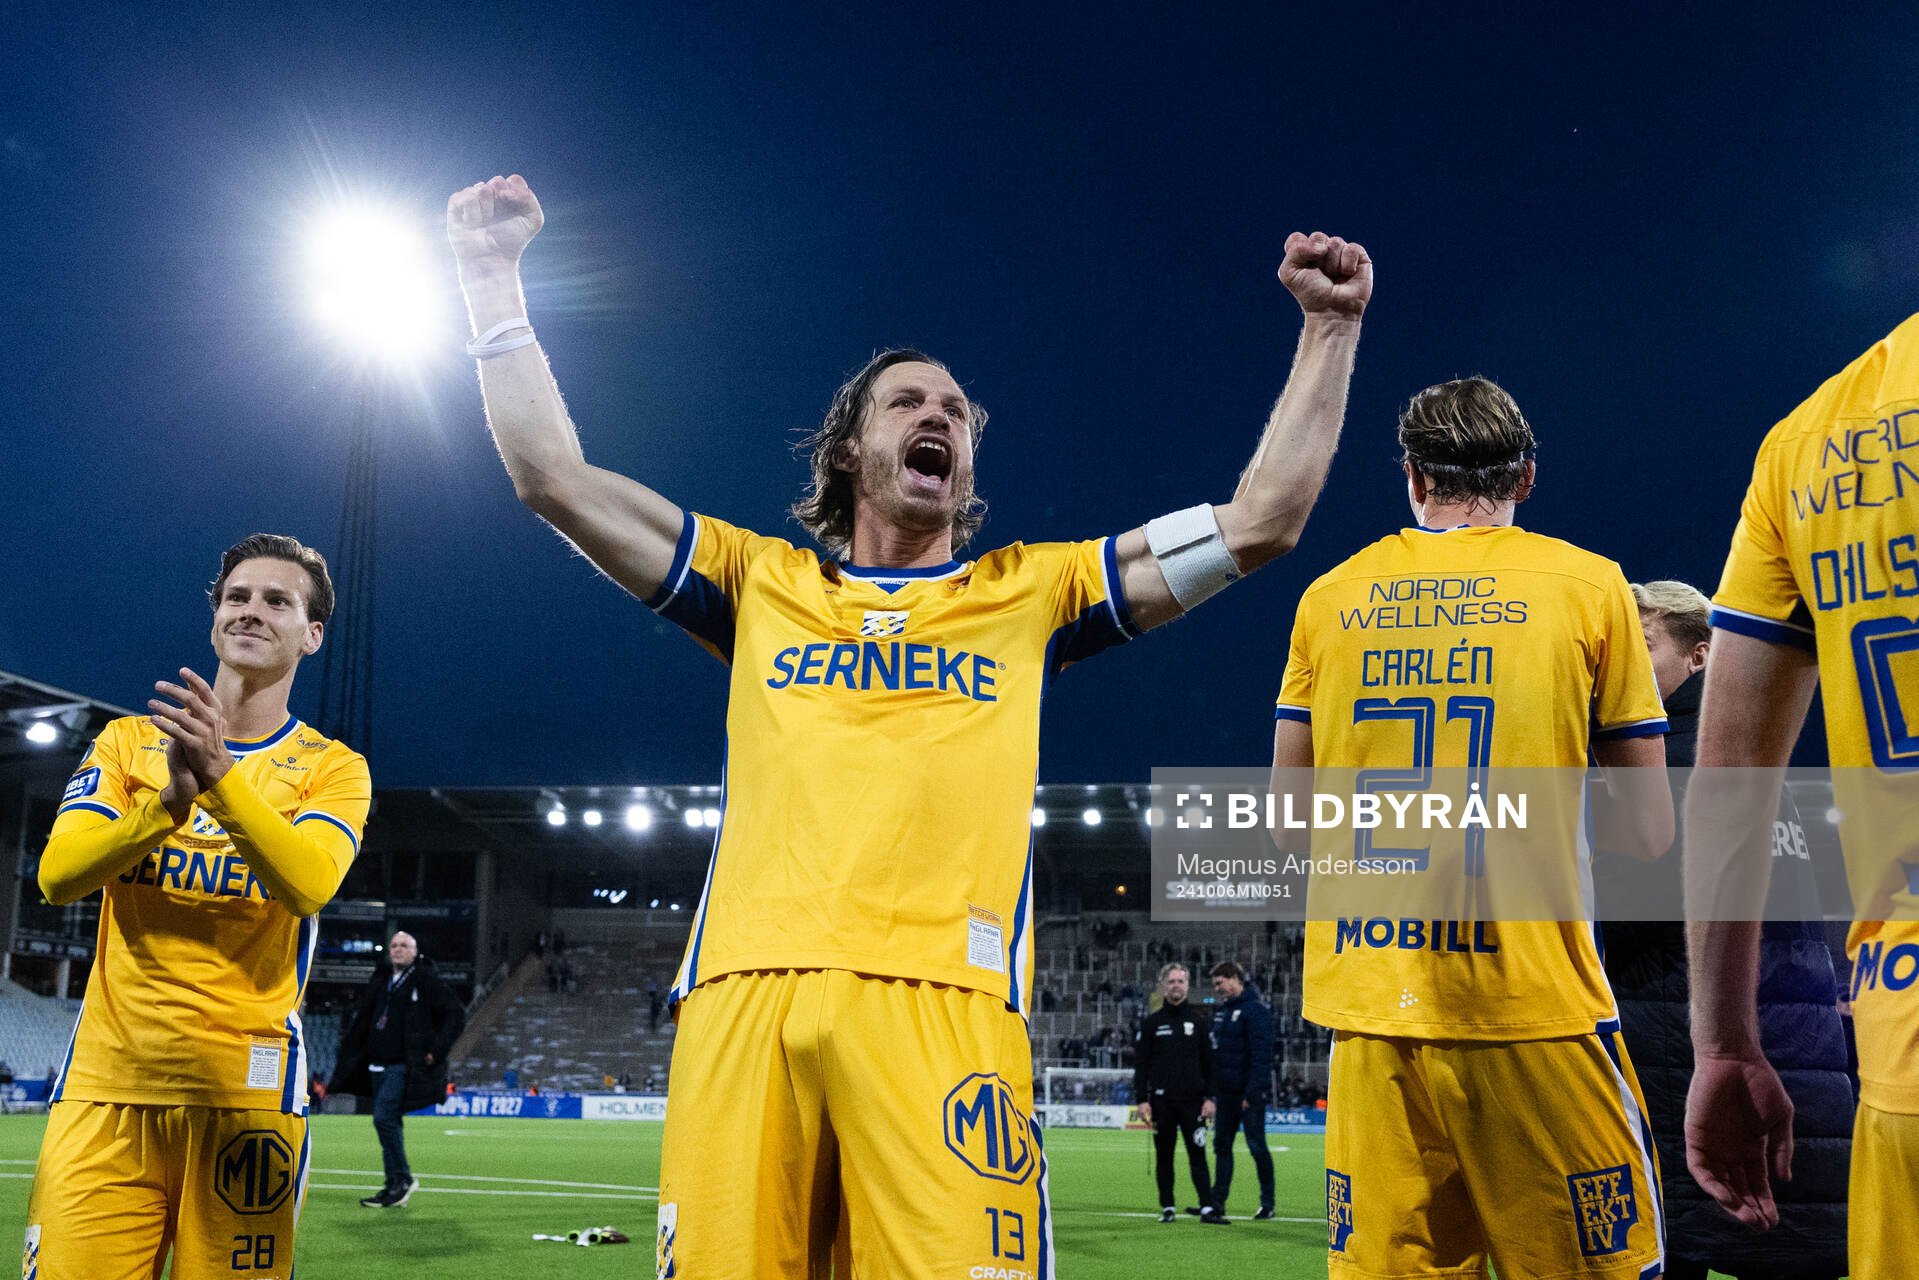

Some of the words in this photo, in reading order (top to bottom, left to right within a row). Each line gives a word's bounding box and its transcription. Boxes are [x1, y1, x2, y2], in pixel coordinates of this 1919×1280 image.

[1369, 577, 1496, 603] NORDIC
[1340, 601, 1528, 630] WELLNESS
[766, 641, 999, 702] SERNEKE
[1362, 638, 1493, 687] CARLÉN
[1353, 695, 1496, 877] 21
[1336, 917, 1498, 954] MOBILL
[954, 1084, 1029, 1174] MG
[222, 1138, 290, 1208] MG
[1573, 1171, 1622, 1202] EFF
[1578, 1193, 1631, 1228] EKT
[231, 1234, 275, 1270] 28
[985, 1207, 1025, 1262] 13
[1583, 1222, 1614, 1252] IV
